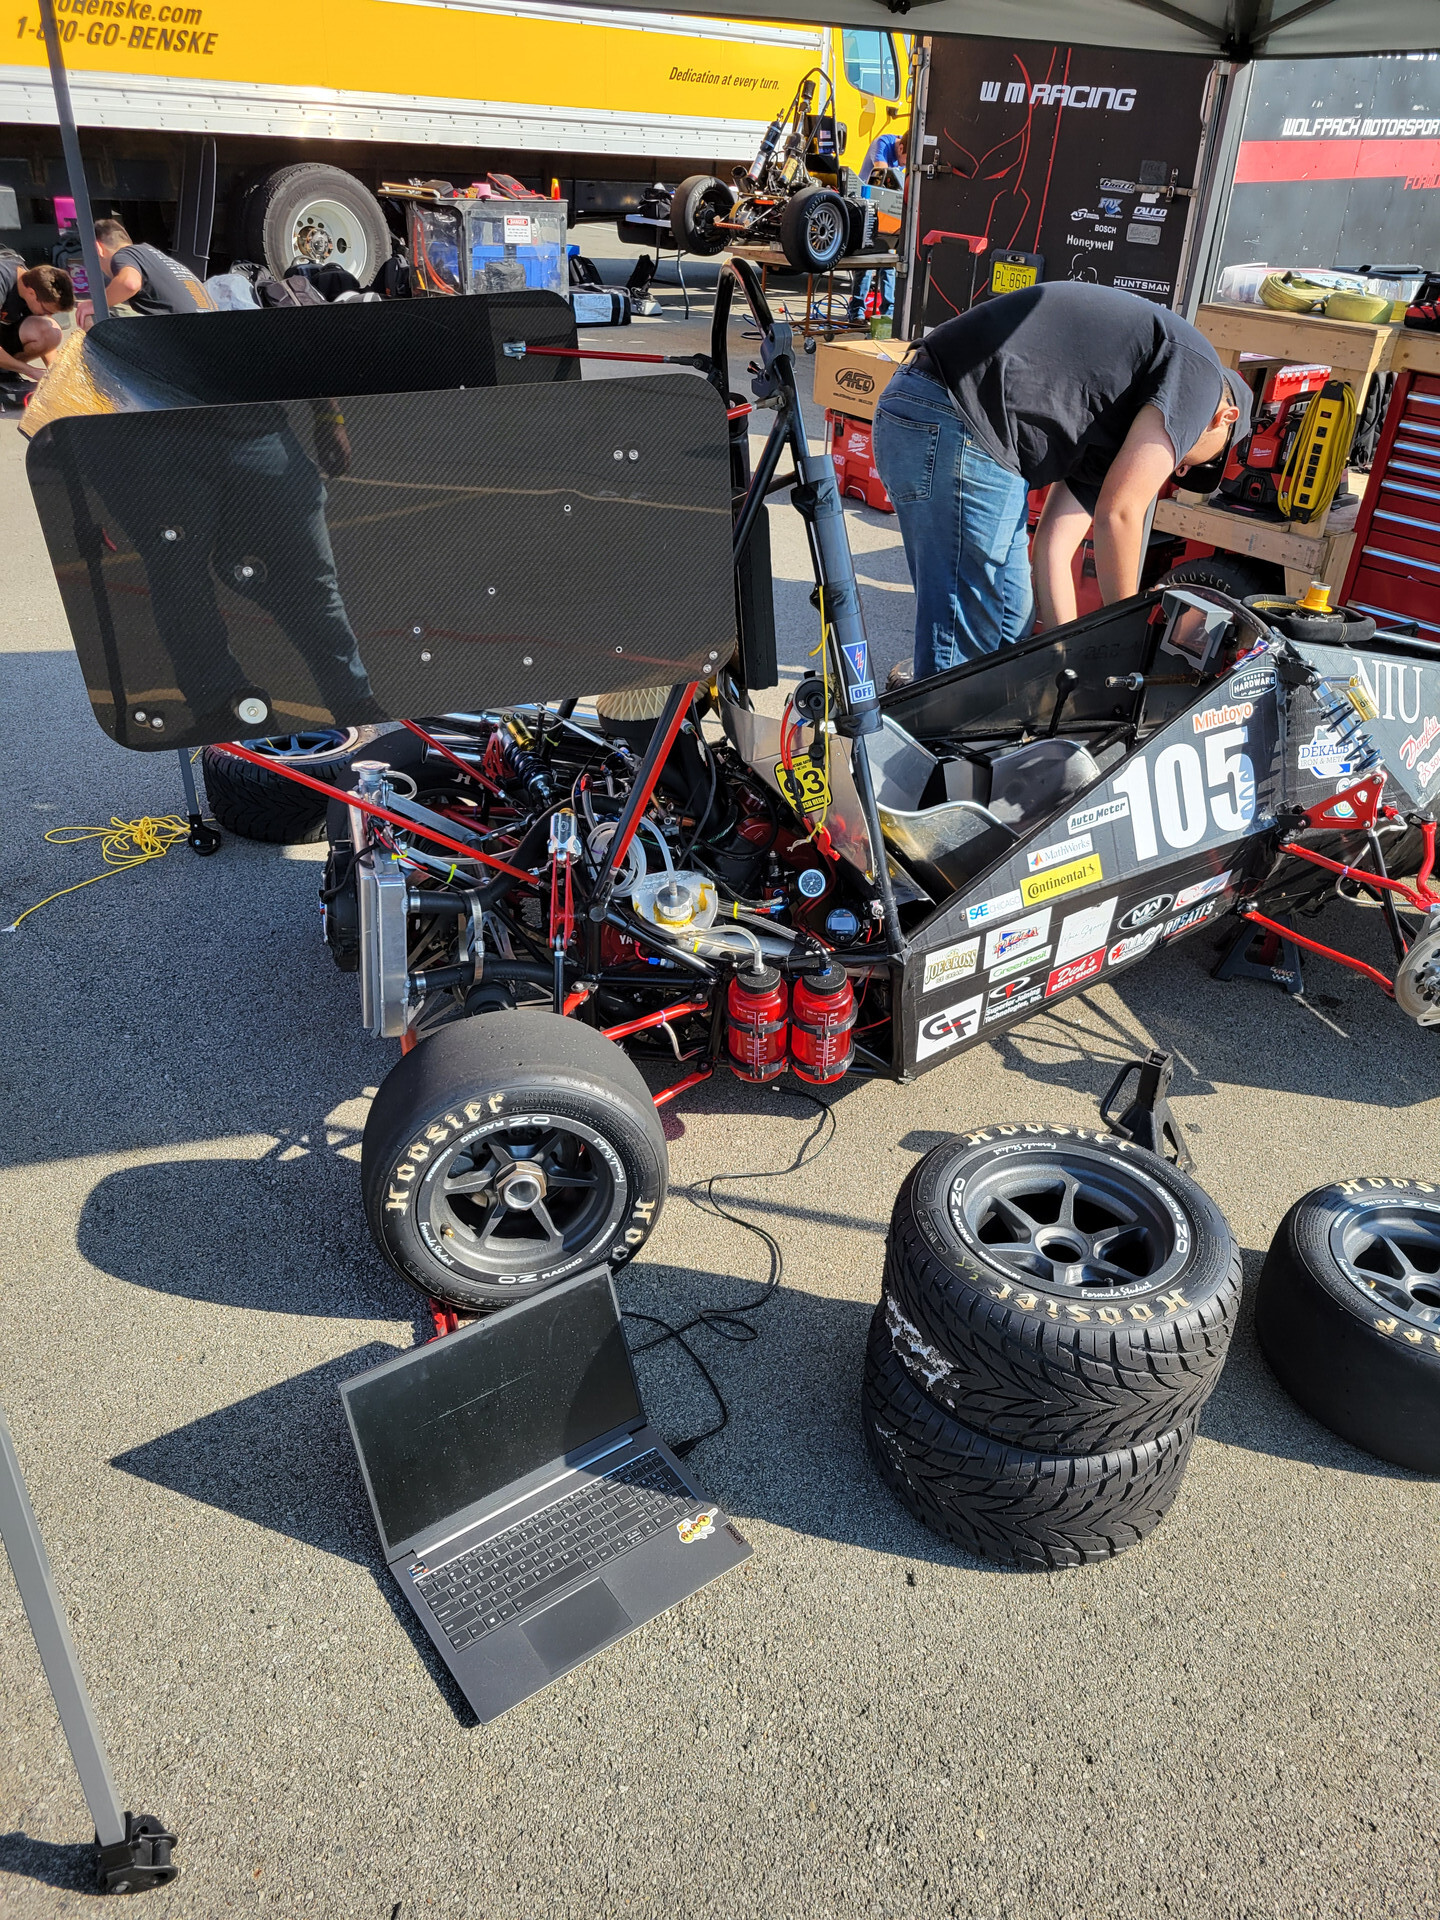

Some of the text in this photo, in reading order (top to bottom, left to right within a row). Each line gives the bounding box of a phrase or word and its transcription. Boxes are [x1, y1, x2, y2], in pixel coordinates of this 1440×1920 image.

[669, 66, 780, 91] Dedication at every turn.
[980, 81, 1137, 111] W M RACING
[1281, 118, 1440, 136] WOLFPACK MOTORSPOR
[1134, 206, 1167, 217] CALICO
[1066, 234, 1114, 251] Honeywell
[1095, 224, 1116, 234] BOSCH
[1113, 279, 1171, 292] HUNTSMAN
[854, 686, 872, 698] OFF
[1234, 676, 1276, 693] HARDWARE
[1352, 657, 1423, 724] NIU
[1194, 703, 1252, 732] Mitutoyo
[784, 770, 825, 802] 93
[1112, 726, 1256, 861] 105
[1071, 803, 1126, 830] Auto Meter
[1044, 840, 1090, 861] MathWorks
[1027, 866, 1087, 899] Continental
[969, 903, 989, 920] SAE
[1163, 898, 1217, 937] ROSATI'S
[1051, 965, 1098, 991] BODY SHOP
[1058, 956, 1096, 982] Dick's
[986, 988, 1041, 1015] Superior Joining
[922, 1009, 977, 1044] GF
[460, 1120, 505, 1143] RACING
[963, 1121, 1138, 1151] Hoosier
[384, 1093, 506, 1216] Hoosier
[1156, 1187, 1184, 1221] RACING
[1359, 1199, 1398, 1208] RACING
[951, 1208, 975, 1245] RACING
[419, 1221, 437, 1249] Formula
[432, 1244, 455, 1266] Student
[541, 1257, 583, 1279] RACING
[978, 1251, 1022, 1280] MAGNESIUM
[1081, 1281, 1153, 1298] Formula Student
[987, 1282, 1192, 1326] Hoosier
